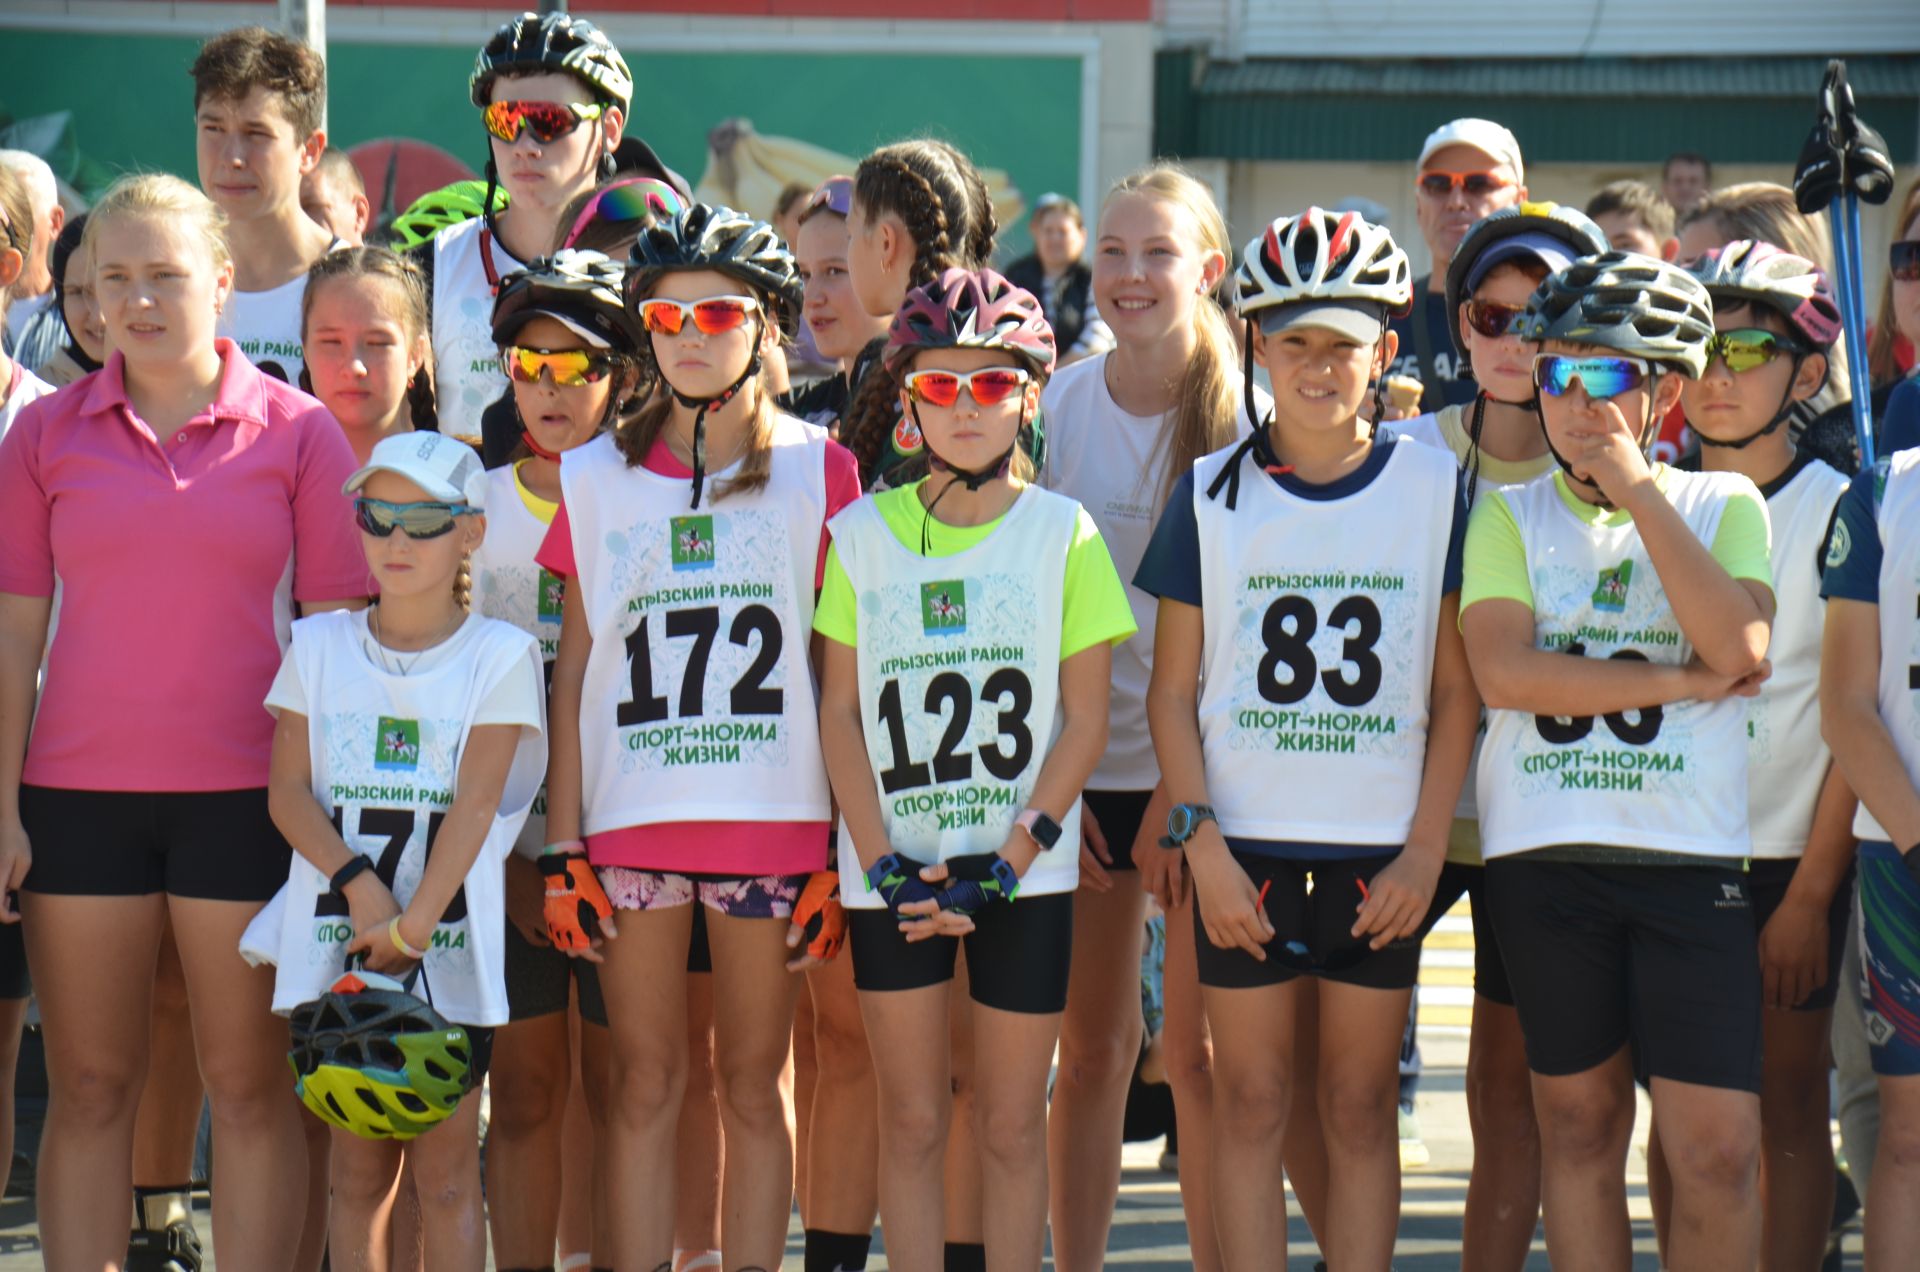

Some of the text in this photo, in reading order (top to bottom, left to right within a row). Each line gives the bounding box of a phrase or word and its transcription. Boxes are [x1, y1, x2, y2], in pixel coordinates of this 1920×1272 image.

[264, 342, 304, 358] РАЙО
[470, 359, 499, 373] АГР
[1247, 571, 1404, 590] АГРЫЗСКИЙ РАЙОН
[627, 579, 774, 613] АГРЫЗСКИЙ РАЙОН
[879, 643, 1025, 676] АГРЫЗСКИЙ РАЙОН
[1257, 593, 1383, 708] 83
[616, 603, 784, 728] 172
[878, 667, 1034, 795] 123
[1239, 710, 1397, 734] СПОРТ НОРМА
[628, 722, 778, 751] СПОРТ НОРМА
[1274, 731, 1356, 753] ЖИЗНИ
[662, 744, 741, 767] ЖИЗНИ
[1524, 750, 1685, 775] СПОРТ НОРМА
[1559, 771, 1643, 792] ЖИЗНИ
[936, 807, 986, 830] ЖИЗНИ
